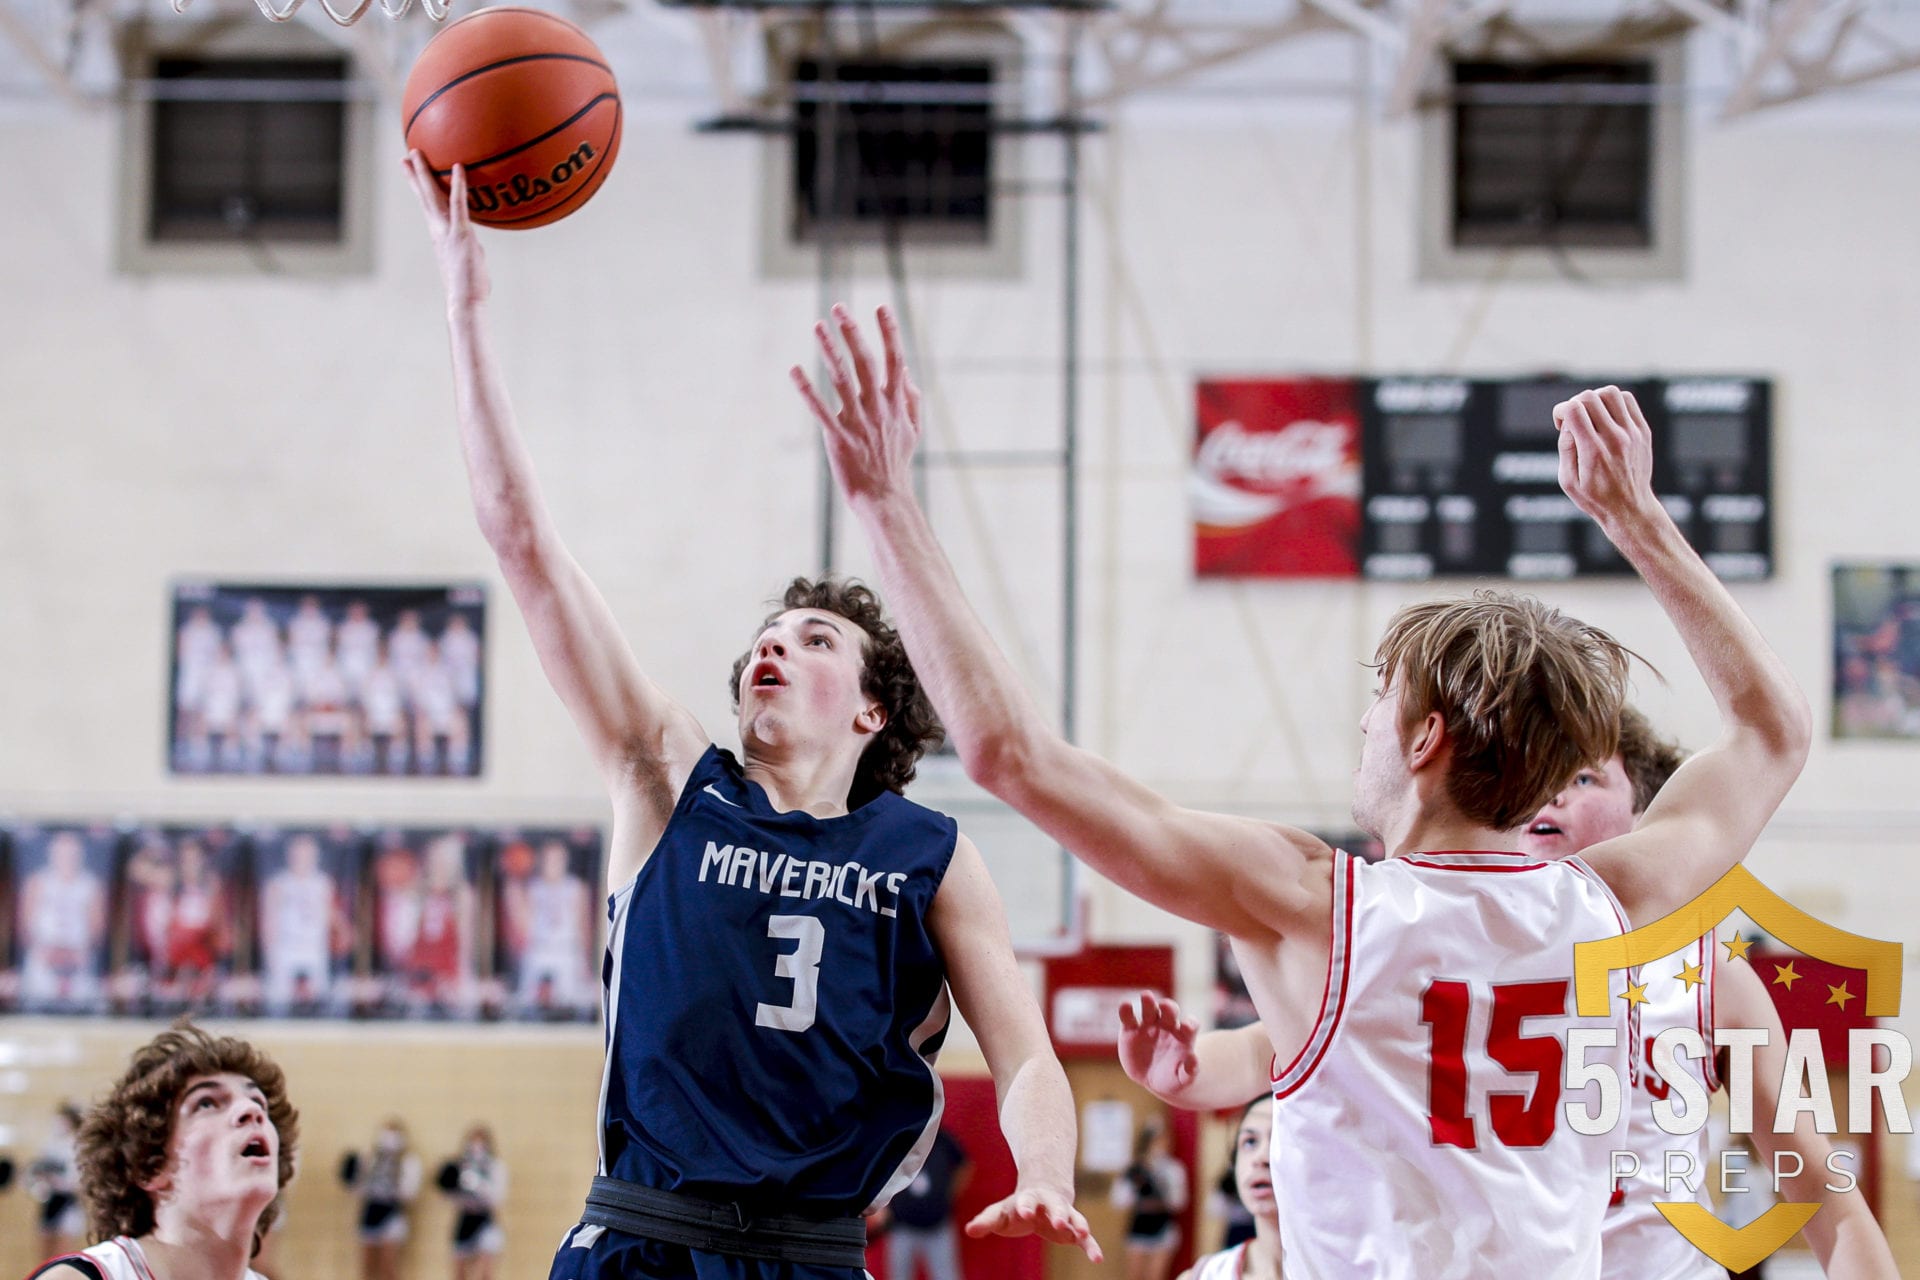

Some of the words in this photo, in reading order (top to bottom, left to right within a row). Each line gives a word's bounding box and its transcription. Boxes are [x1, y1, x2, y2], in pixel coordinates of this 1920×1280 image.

[467, 141, 597, 212] Wilson
[698, 841, 908, 919] MAVERICKS
[755, 915, 825, 1032] 3
[1418, 976, 1569, 1151] 15
